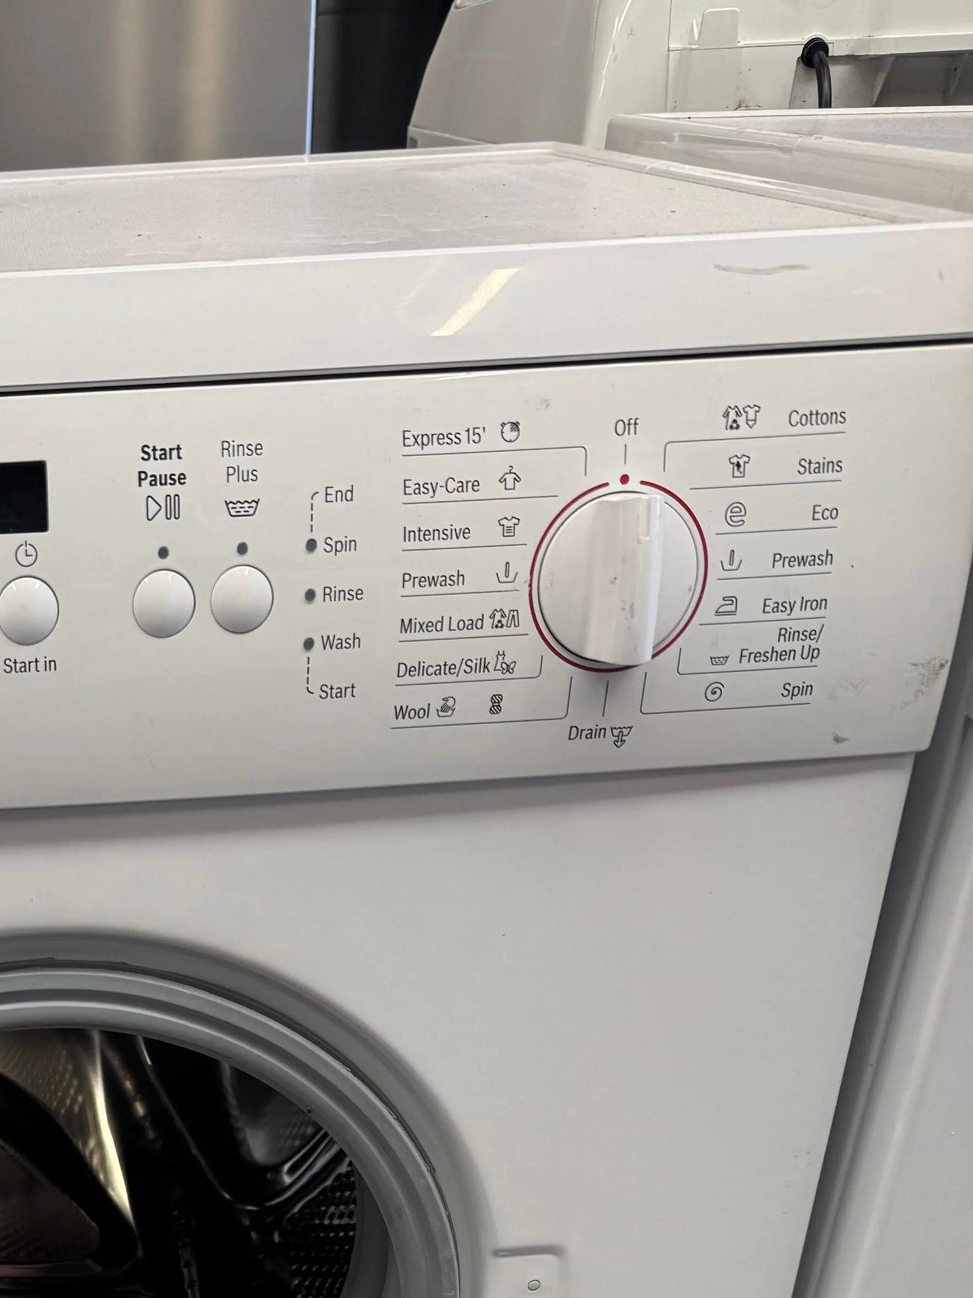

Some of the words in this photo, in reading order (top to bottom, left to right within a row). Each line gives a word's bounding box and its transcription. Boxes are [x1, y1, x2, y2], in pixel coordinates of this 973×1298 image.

[614, 417, 640, 437] Off
[787, 407, 847, 428] Cottons
[220, 440, 264, 459] Rinse
[402, 429, 462, 450] Express
[140, 443, 183, 462] Start
[226, 465, 259, 484] Plus
[796, 456, 844, 477] Stains
[137, 468, 187, 488] Pause
[402, 477, 481, 498] Easy-Care
[324, 485, 355, 504] End
[811, 504, 839, 522] Eco
[402, 523, 472, 543] Intensive
[323, 534, 358, 557] Spin
[771, 549, 834, 570] Prewash
[401, 570, 466, 590] Prewash
[322, 584, 365, 603] Rinse
[762, 597, 796, 618] Easy
[799, 595, 828, 613] Iron
[399, 616, 445, 636] Mixed
[448, 613, 485, 633] Load
[777, 623, 826, 645] Rinse/
[321, 632, 362, 652] Wash
[2, 656, 39, 675] Start
[43, 655, 58, 673] in
[738, 646, 796, 666] Freshen
[800, 645, 821, 663] Up
[396, 656, 491, 679] Delicate/Silk
[319, 682, 357, 701] Start
[780, 681, 814, 702] Spin
[393, 702, 431, 721] Wool
[568, 723, 607, 742] Drain
